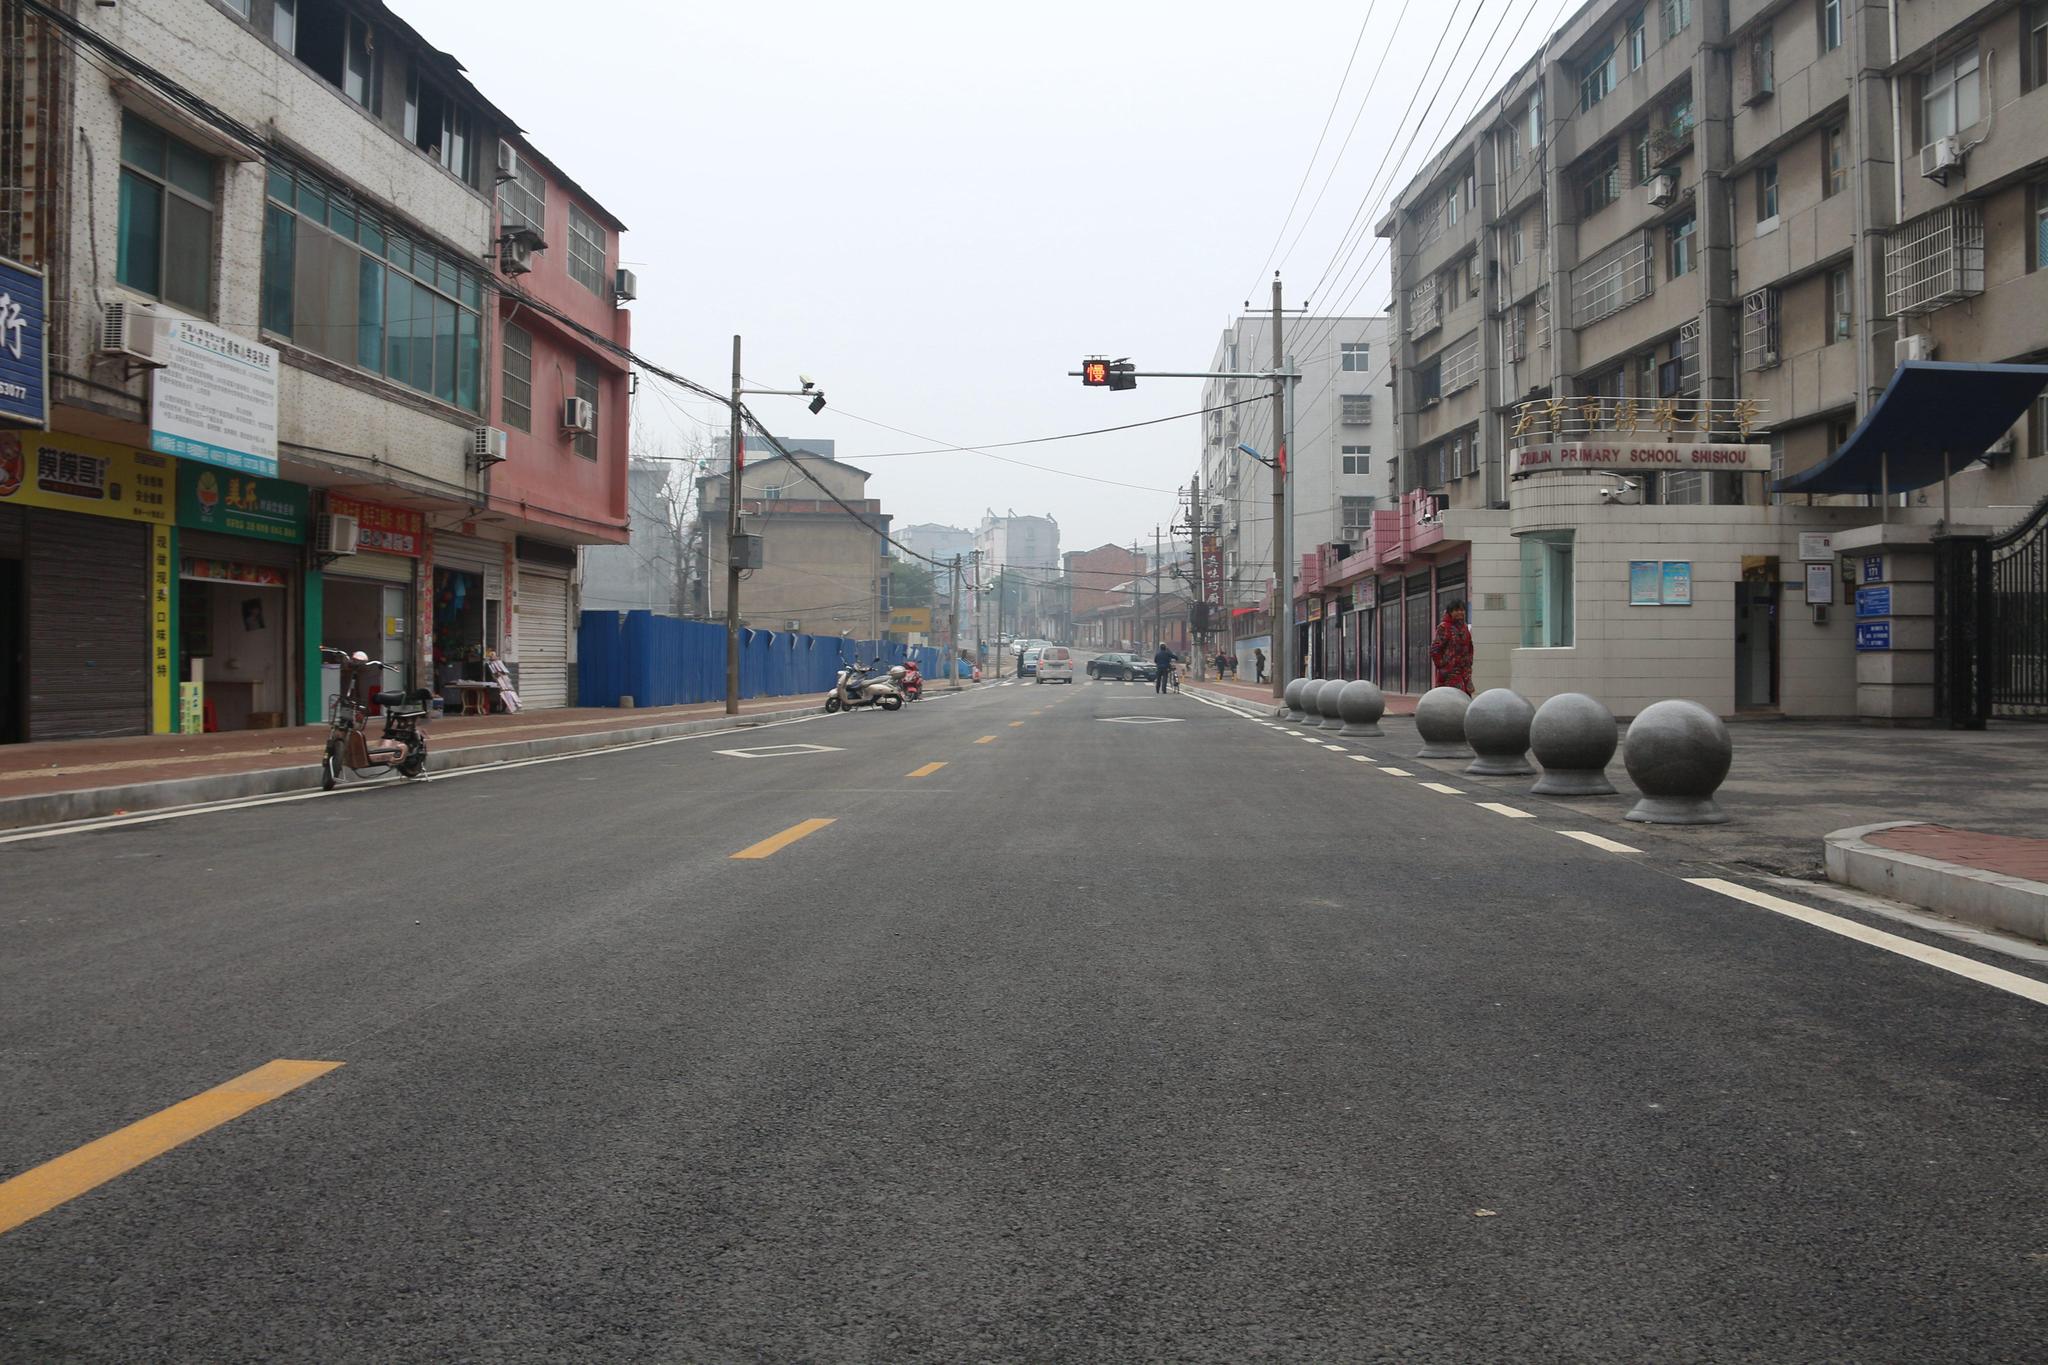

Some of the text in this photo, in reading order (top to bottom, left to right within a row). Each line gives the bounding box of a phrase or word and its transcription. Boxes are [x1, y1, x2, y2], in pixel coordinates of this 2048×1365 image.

[1087, 363, 1105, 382] 慢
[1561, 448, 1620, 463] PRIMARY
[1630, 449, 1682, 464] SCHOOL
[1692, 449, 1747, 464] SHISHOU
